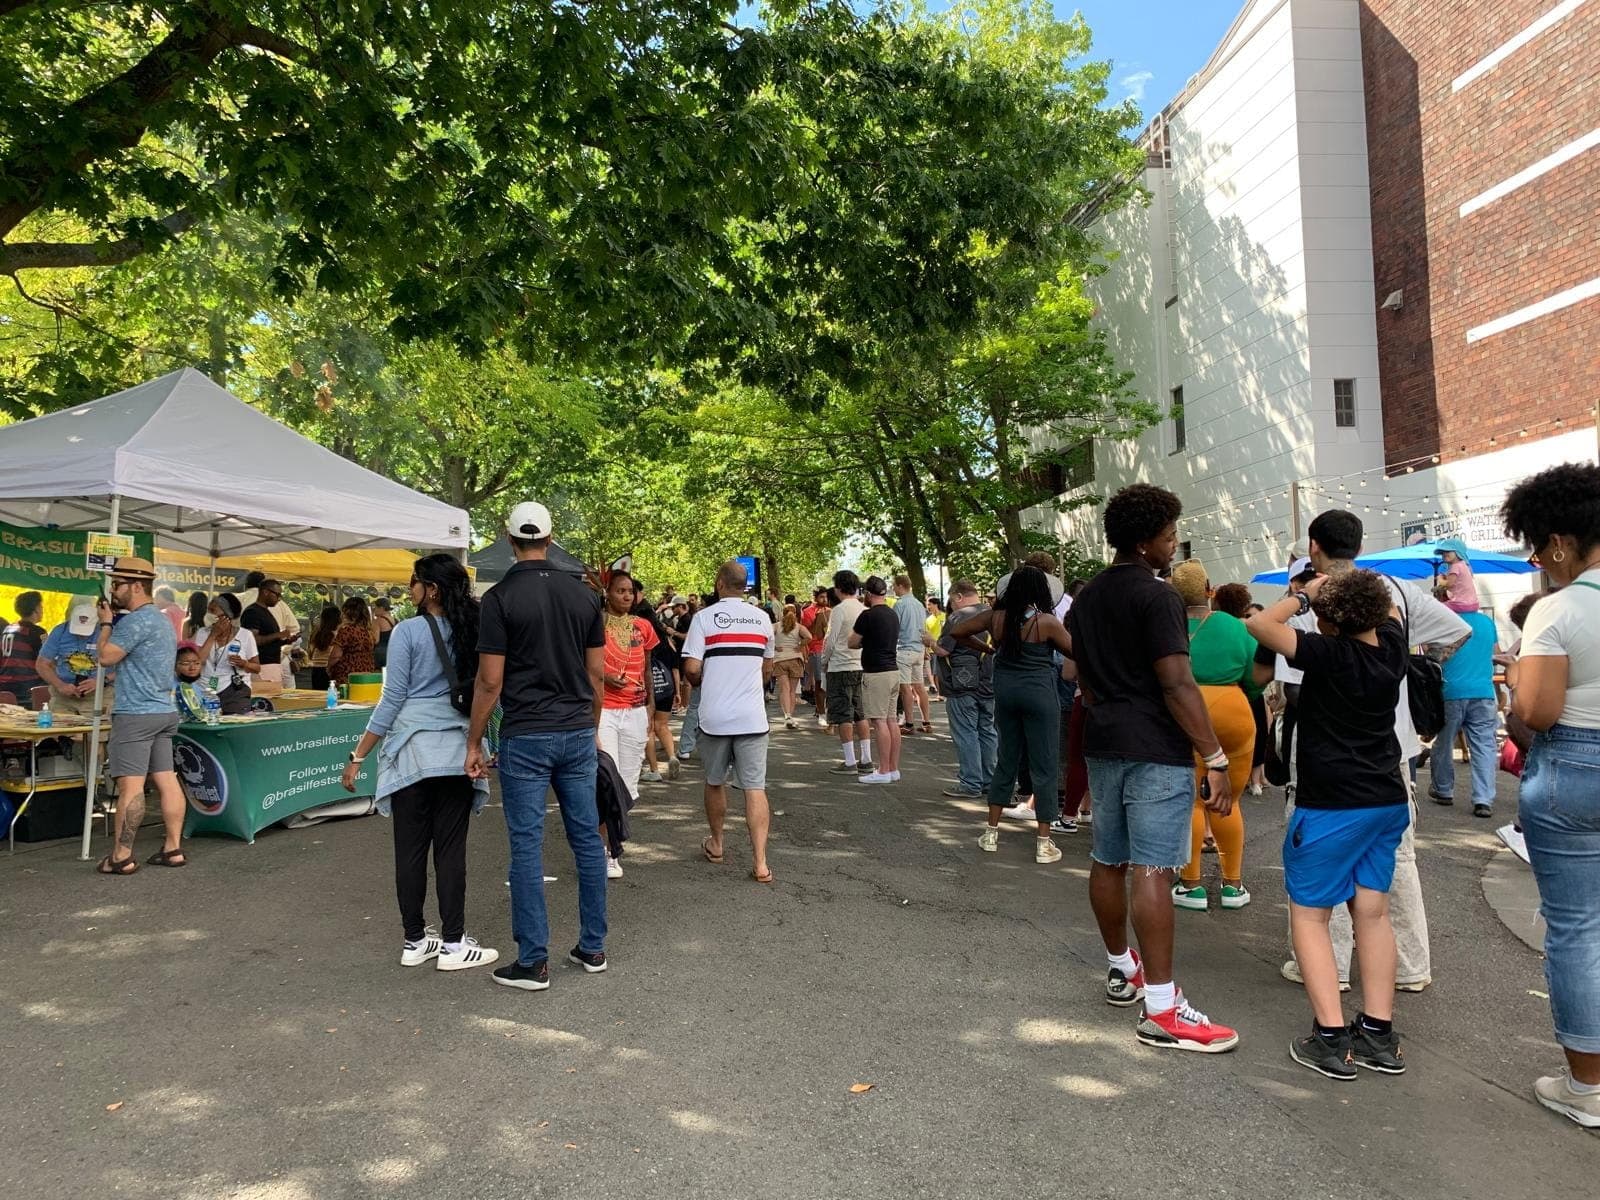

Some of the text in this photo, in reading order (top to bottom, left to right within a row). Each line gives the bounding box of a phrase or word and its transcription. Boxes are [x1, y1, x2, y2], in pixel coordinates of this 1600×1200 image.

[1433, 515, 1501, 536] BLUE WATE
[718, 616, 762, 626] Sportsbet.io
[261, 734, 364, 757] www.brasilfest.or
[289, 762, 345, 782] Follow us
[262, 771, 368, 809] @brasilfestsetle
